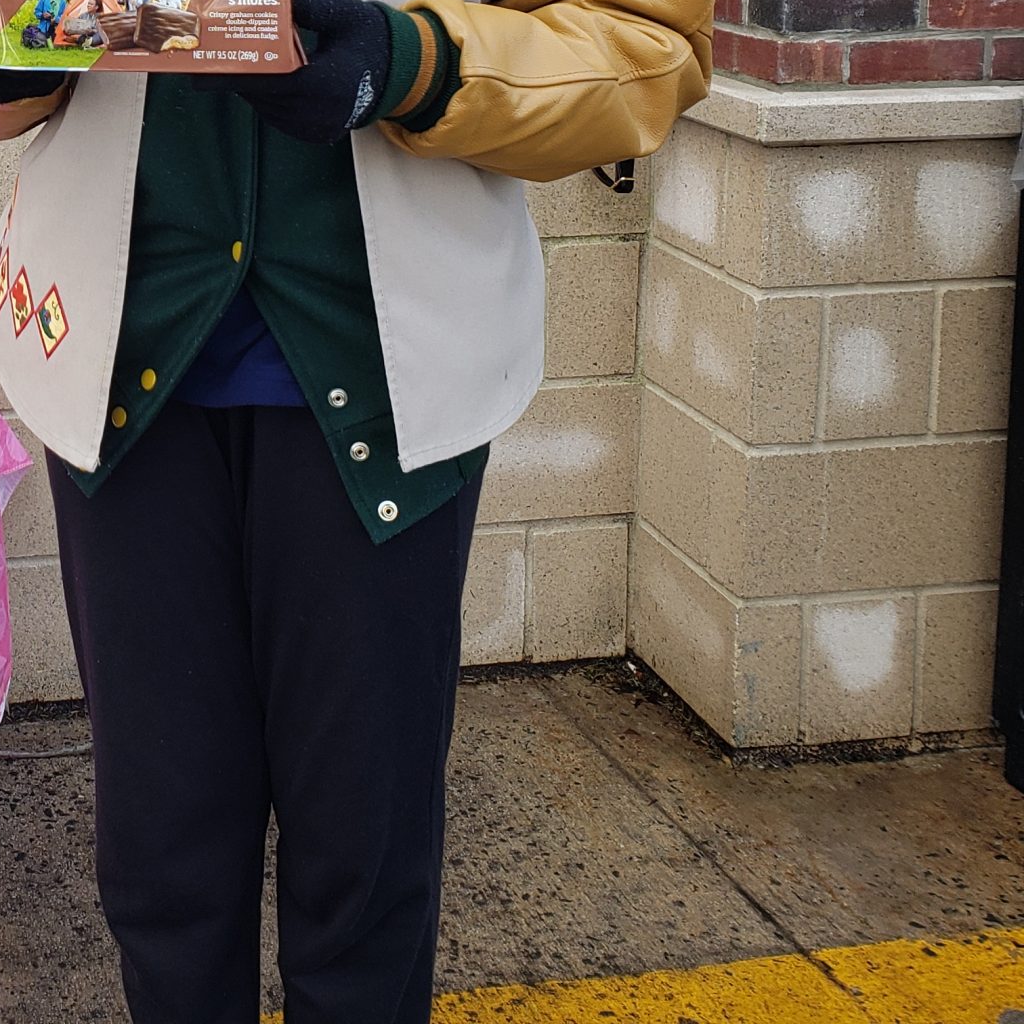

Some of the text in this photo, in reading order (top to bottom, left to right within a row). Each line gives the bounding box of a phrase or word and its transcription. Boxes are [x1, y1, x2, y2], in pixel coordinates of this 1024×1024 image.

[208, 11, 229, 19] Crispy
[229, 11, 254, 19] graham
[193, 50, 204, 59] NET
[206, 50, 216, 59] WT
[227, 51, 237, 60] OZ
